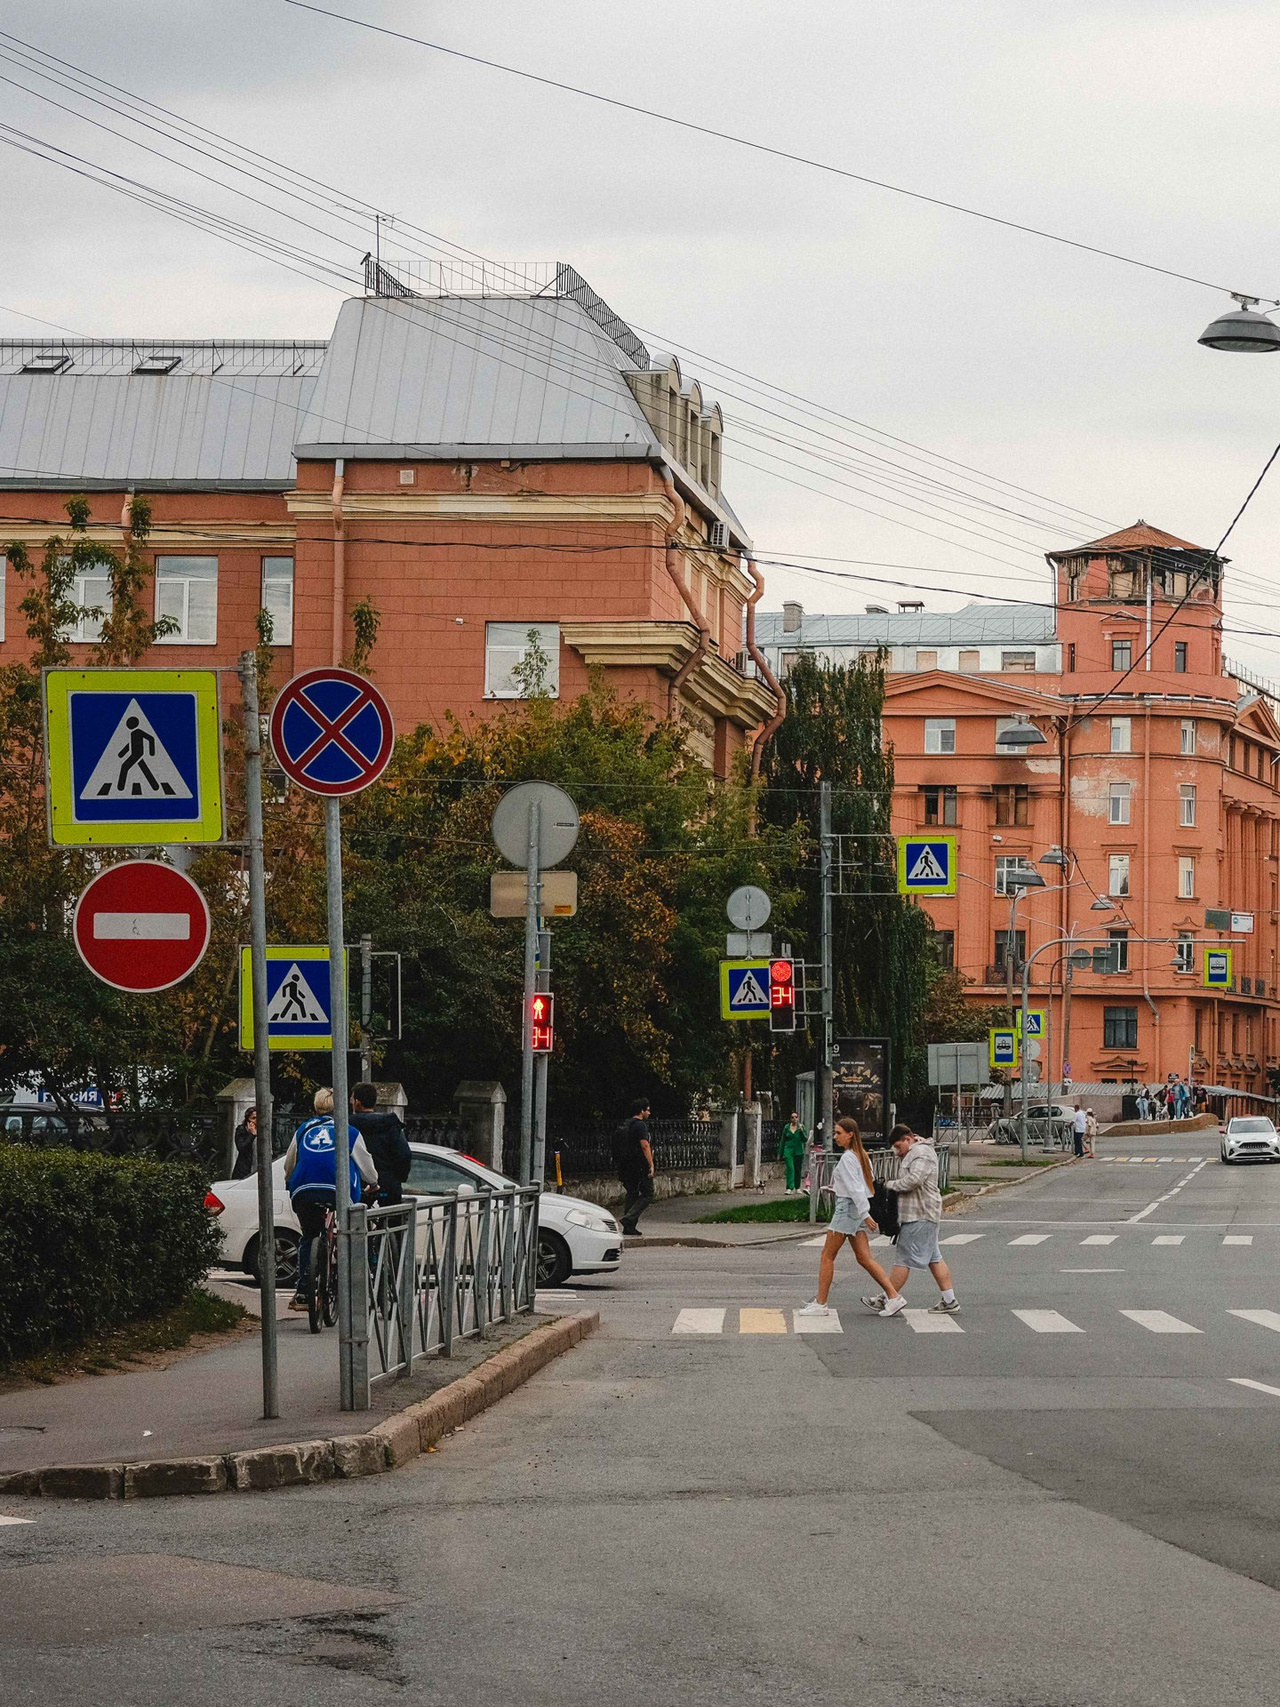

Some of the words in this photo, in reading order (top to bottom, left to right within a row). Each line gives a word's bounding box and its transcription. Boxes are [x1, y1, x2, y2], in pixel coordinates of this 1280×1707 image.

[772, 986, 792, 1005] 34
[533, 1026, 550, 1047] 34
[310, 1128, 333, 1145] A
